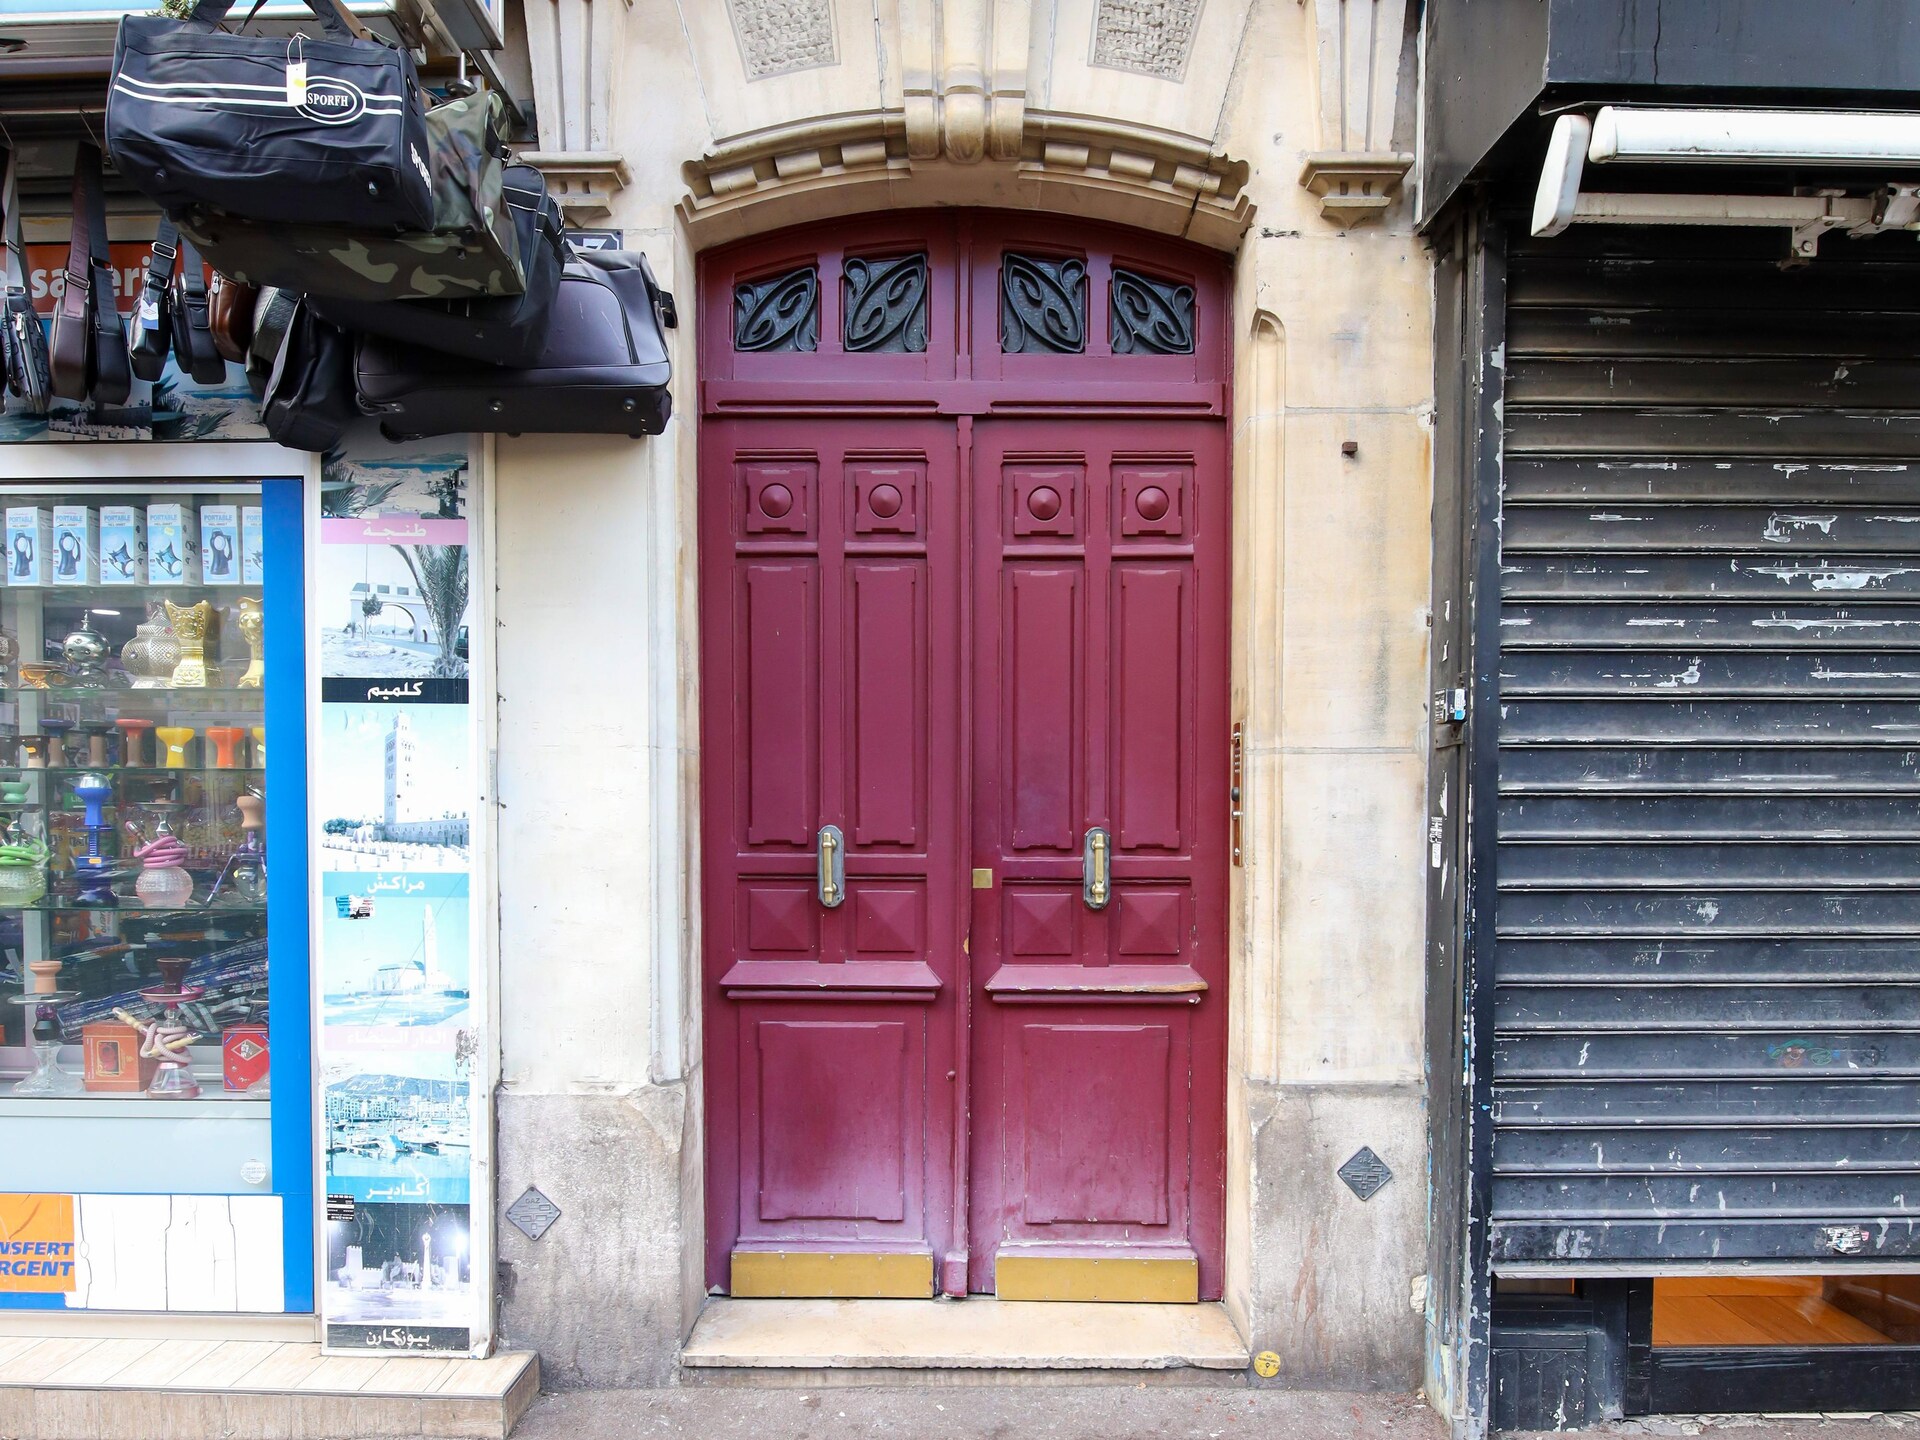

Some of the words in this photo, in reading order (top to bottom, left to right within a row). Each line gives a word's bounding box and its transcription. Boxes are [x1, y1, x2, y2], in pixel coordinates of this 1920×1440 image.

[307, 92, 349, 107] SPORFH
[363, 521, 427, 540] طنجة
[367, 681, 424, 700] كلميم
[366, 873, 426, 894] مراكش
